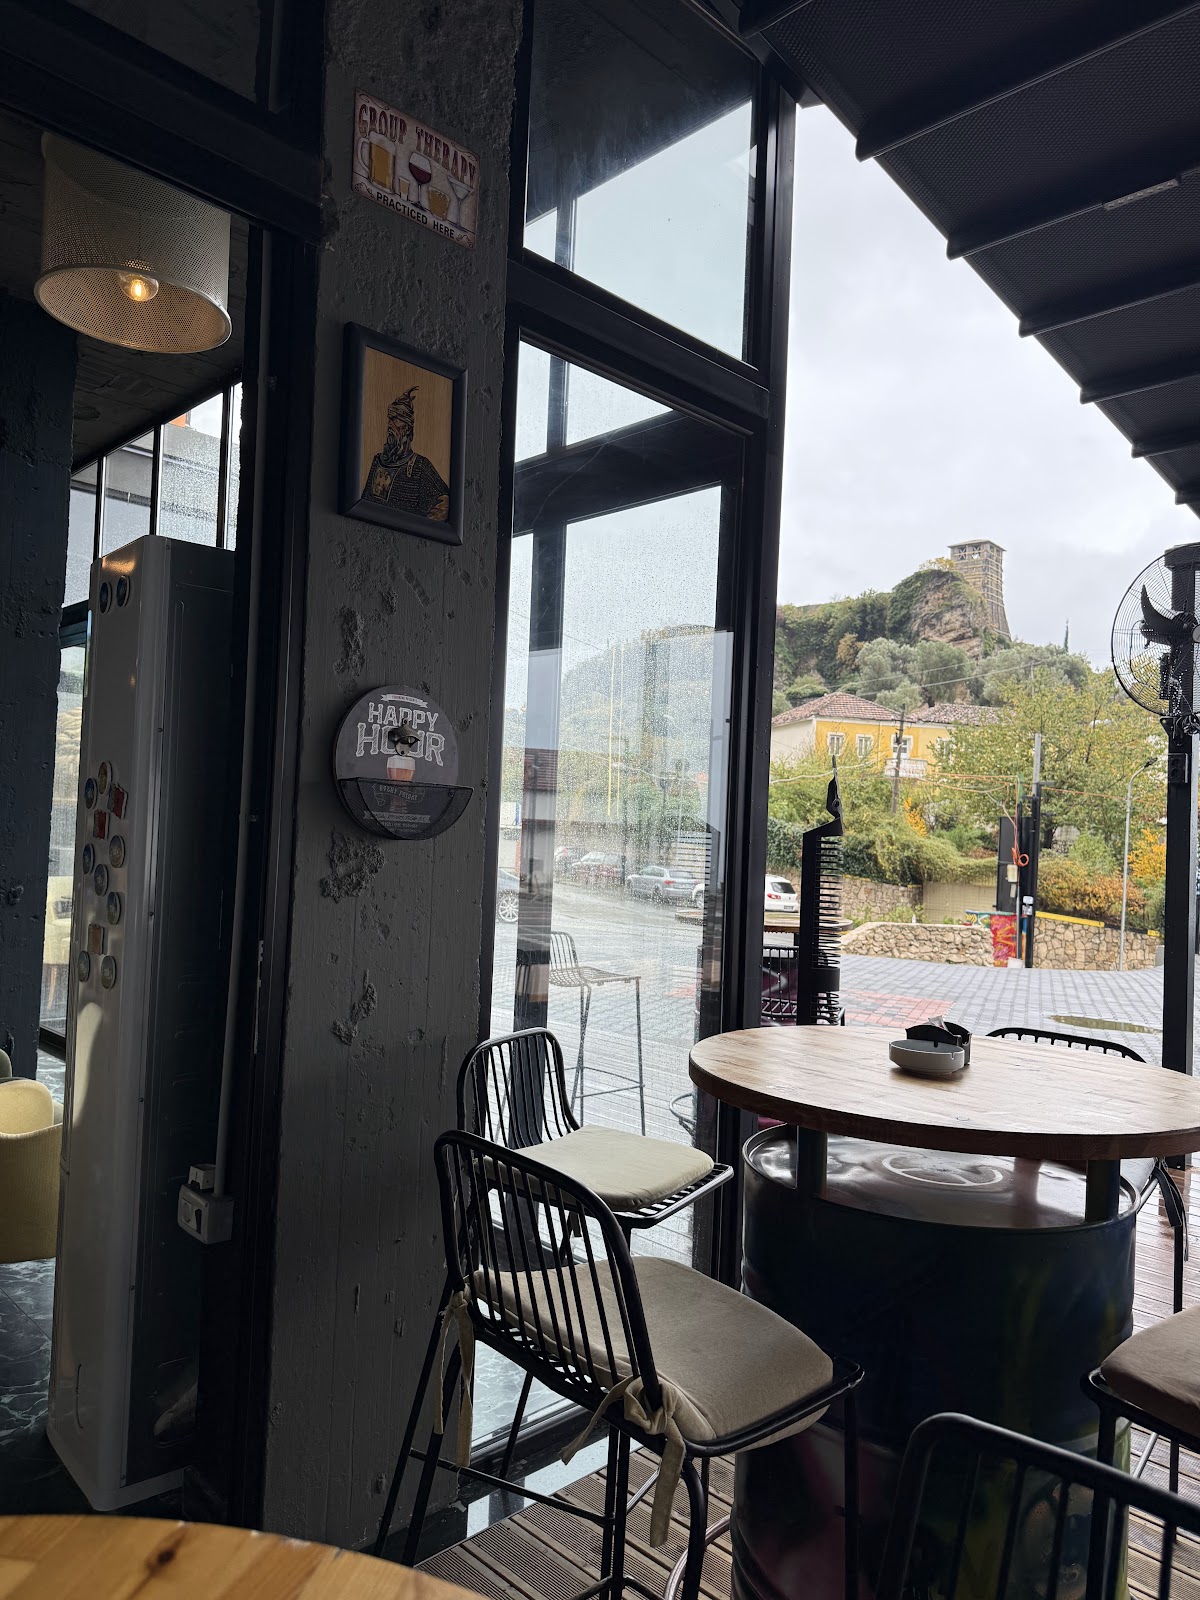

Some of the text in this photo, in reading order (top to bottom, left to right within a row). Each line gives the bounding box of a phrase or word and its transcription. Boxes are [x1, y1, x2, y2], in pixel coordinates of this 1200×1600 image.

[358, 104, 476, 188] GROUP THERAPY
[376, 191, 455, 239] PRACTICED HERE
[368, 702, 439, 731] HAPPY
[399, 790, 418, 801] FRIDAY
